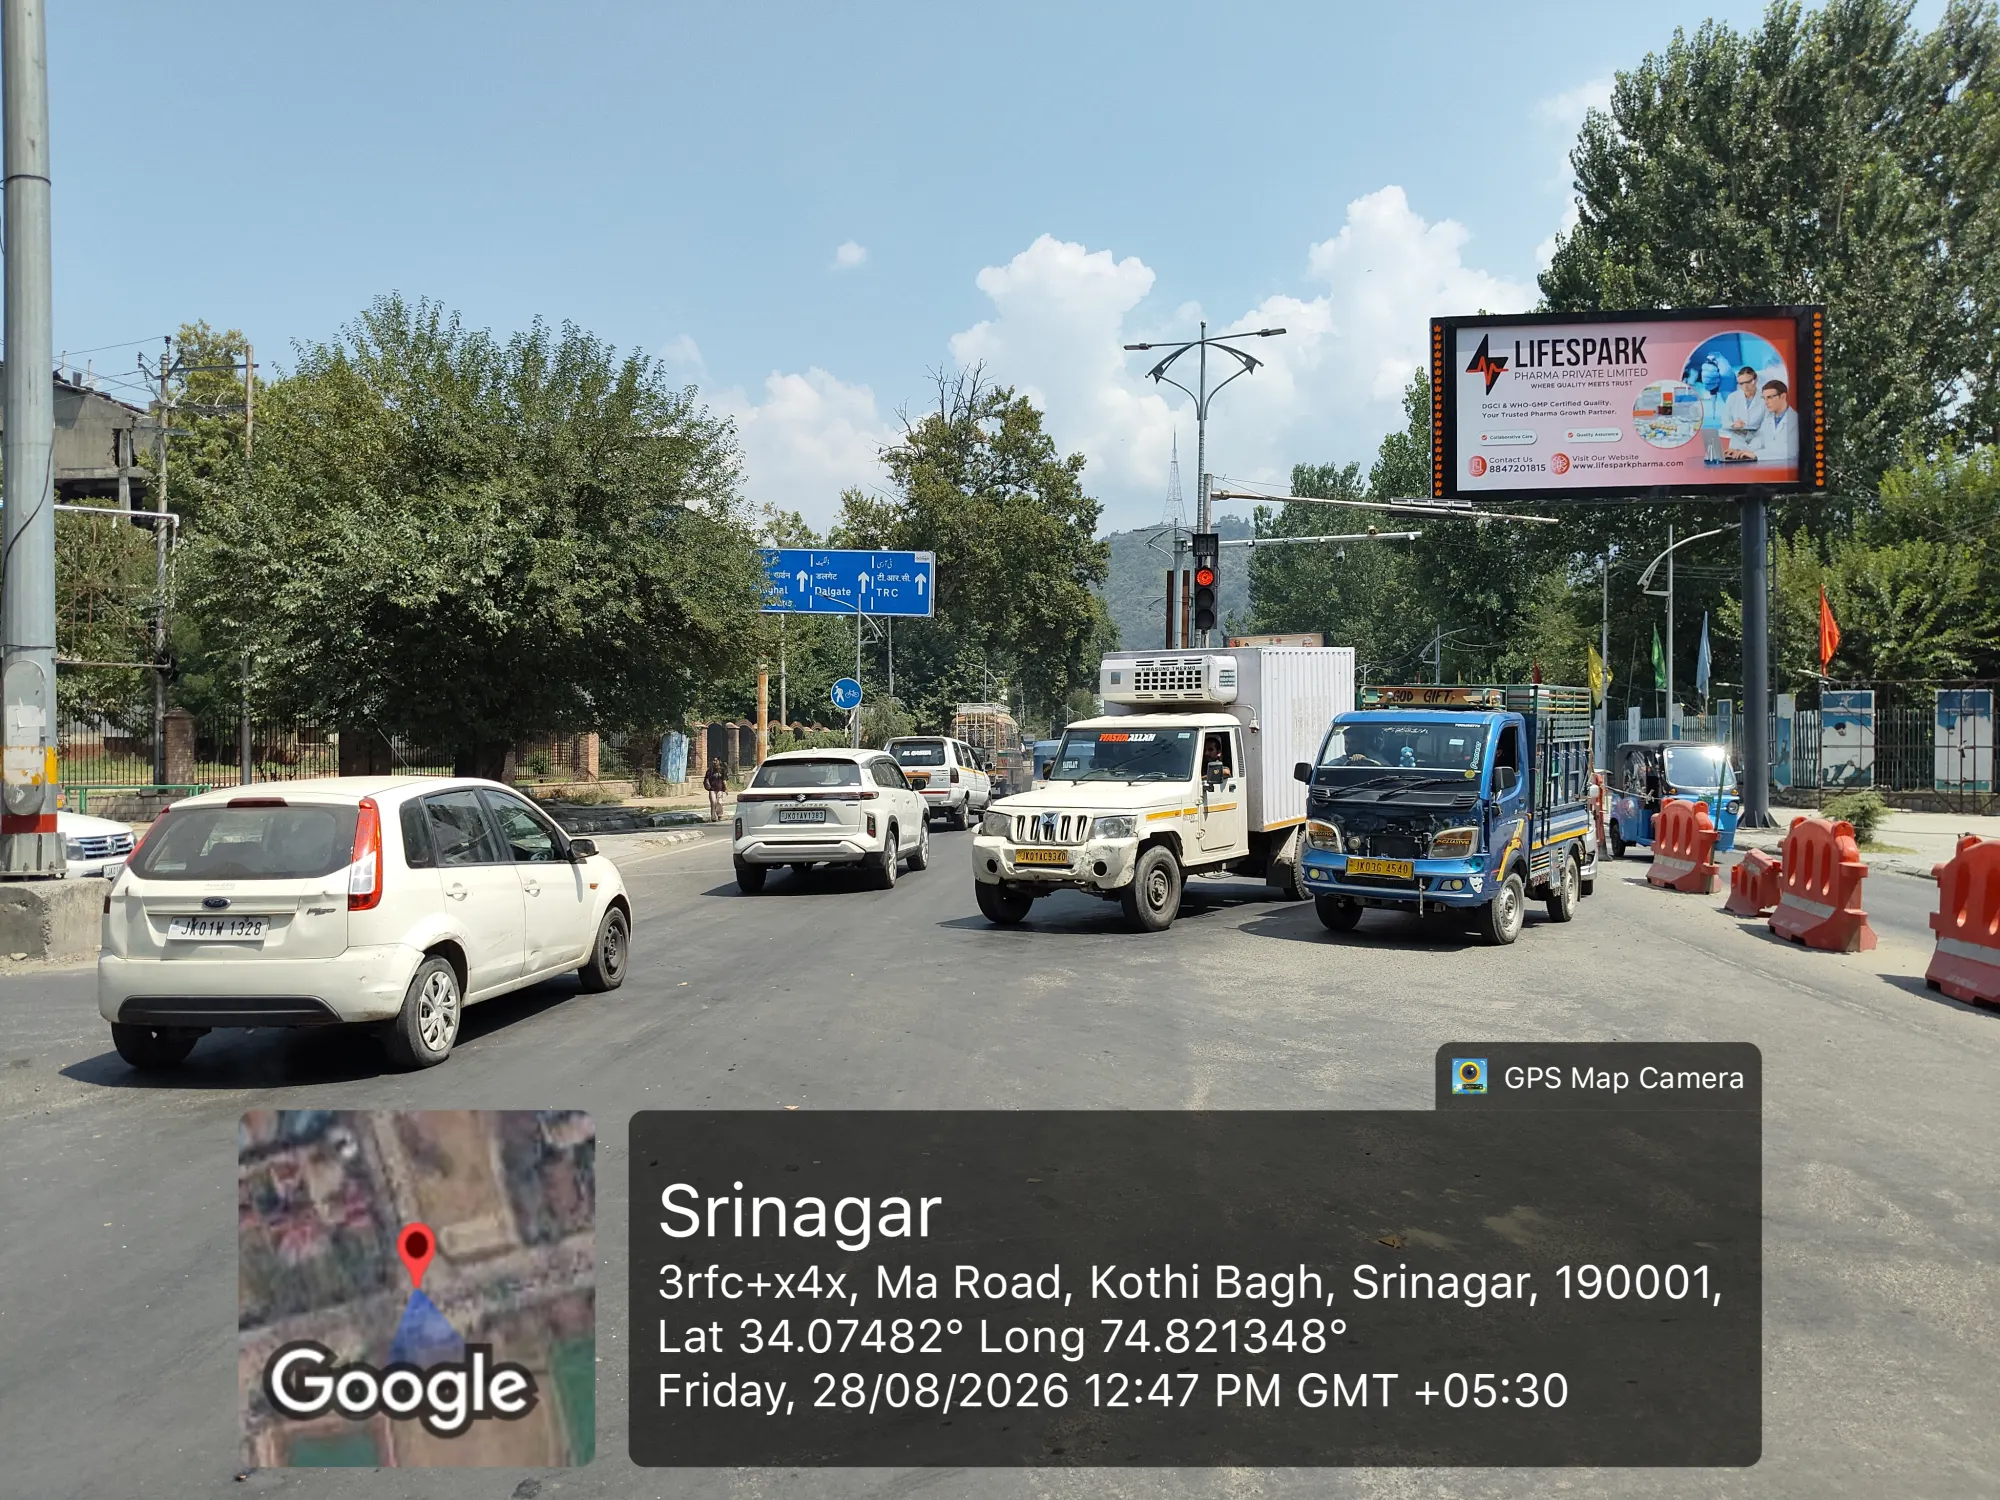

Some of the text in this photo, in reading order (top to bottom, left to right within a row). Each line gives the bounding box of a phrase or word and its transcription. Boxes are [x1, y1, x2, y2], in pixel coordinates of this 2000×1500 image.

[1515, 337, 1648, 368] LIFESPARK
[1515, 368, 1648, 380] PHARMA PRIVATE LIMITED
[1489, 456, 1521, 464] Contact
[1572, 460, 1684, 470] www.lifesparkpharma.com
[1489, 464, 1546, 473] 8847201815
[814, 586, 851, 597] Dalgate
[876, 588, 899, 597] TRC
[1394, 689, 1453, 703] GOD GIFT
[1355, 861, 1409, 874] JK03G 4540
[181, 920, 262, 936] JK01W 1328
